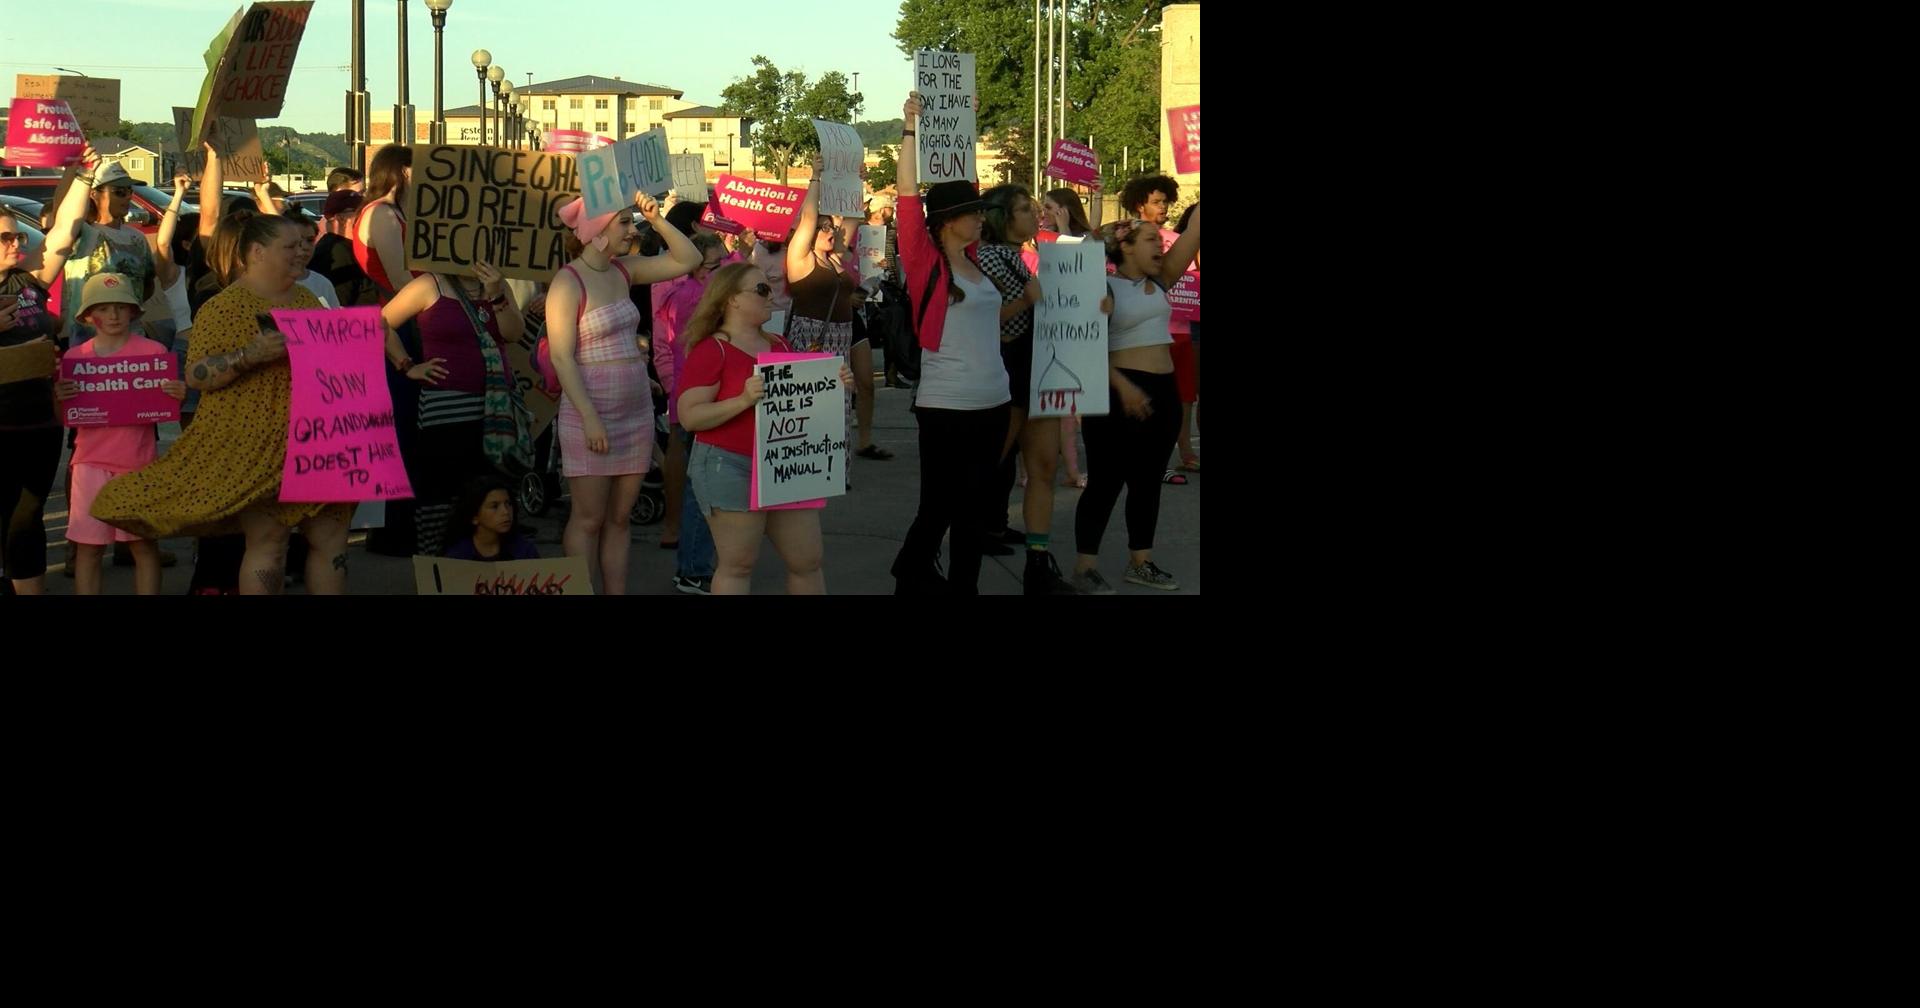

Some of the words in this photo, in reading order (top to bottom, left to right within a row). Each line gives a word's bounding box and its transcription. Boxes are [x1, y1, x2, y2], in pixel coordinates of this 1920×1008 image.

[246, 44, 293, 71] LIFE
[919, 53, 928, 67] I
[932, 54, 960, 70] LONG
[918, 71, 938, 88] FOR
[941, 72, 962, 89] THE
[939, 94, 947, 109] I
[947, 94, 970, 109] HAVE
[24, 118, 56, 131] Safe,
[57, 119, 78, 133] Leg
[919, 115, 930, 130] AS
[932, 115, 959, 131] MANY
[28, 133, 82, 145] Abortion
[919, 133, 951, 153] RIGHTS
[953, 134, 964, 150] AS
[965, 136, 973, 150] A
[928, 151, 965, 178] GUN
[1056, 152, 1084, 165] Health
[425, 146, 527, 188] SINCE
[530, 154, 581, 193] WHE
[726, 180, 785, 200] Abortion
[786, 191, 799, 201] is
[416, 183, 470, 220] DID
[478, 186, 577, 232] RELIG
[718, 193, 763, 211] Health
[765, 203, 793, 215] Care
[412, 219, 524, 269] BECOME
[528, 229, 572, 271] LA
[1057, 250, 1083, 275] will
[1057, 287, 1080, 310] be
[282, 319, 304, 345] I
[308, 318, 375, 345] MARCH
[73, 361, 149, 375] Abortion
[154, 358, 168, 371] is
[761, 364, 793, 383] THE
[316, 369, 343, 405] SO
[343, 371, 367, 400] MY
[763, 402, 795, 417] TALE
[800, 398, 813, 411] IS
[768, 417, 810, 441] NOT
[764, 449, 778, 466] AN
[342, 469, 369, 488] TO
